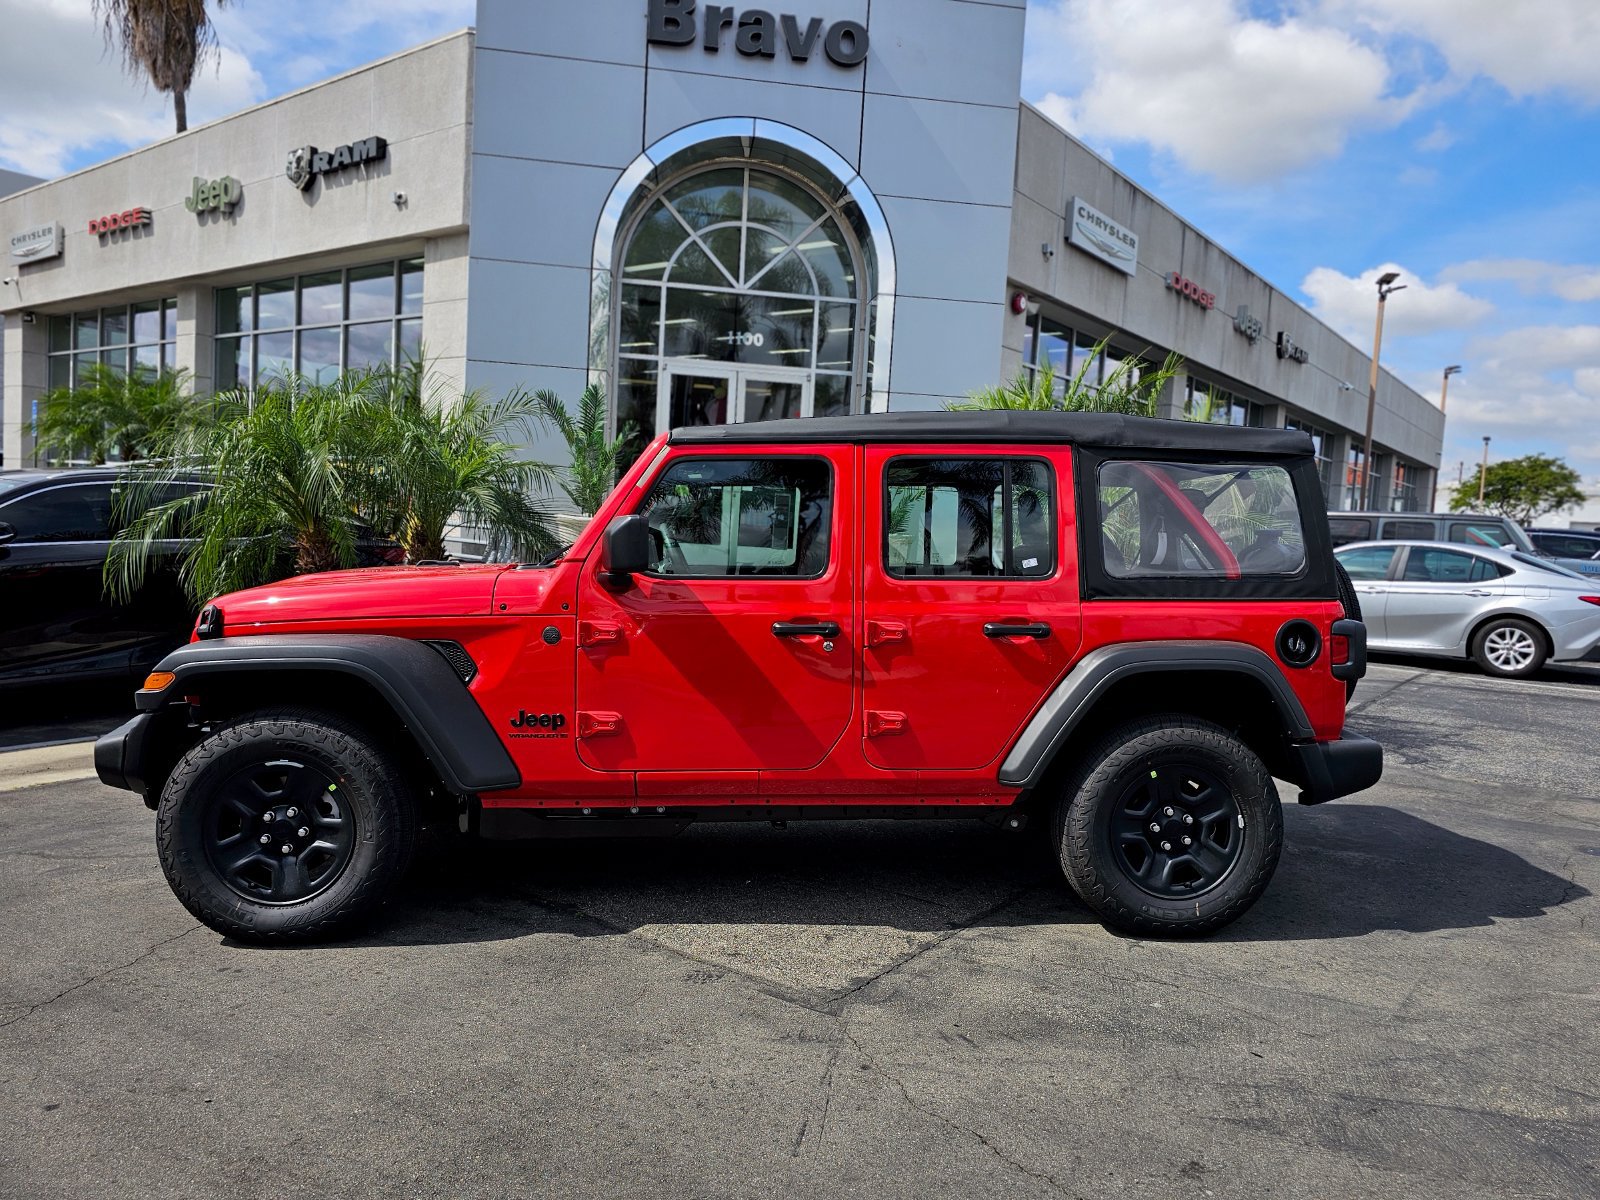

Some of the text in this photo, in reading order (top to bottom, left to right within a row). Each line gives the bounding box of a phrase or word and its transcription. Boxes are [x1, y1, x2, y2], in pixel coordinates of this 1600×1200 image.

[648, 0, 869, 67] Bravo
[312, 136, 387, 174] RAM
[185, 175, 241, 213] Jeep
[11, 226, 53, 246] CHRYSLER
[88, 207, 150, 235] DODGE
[1078, 206, 1136, 249] CHRYSLER
[1168, 272, 1215, 310] DODGE
[727, 330, 764, 347] 1100
[1233, 304, 1263, 344] Jeep
[510, 709, 565, 730] Jeep
